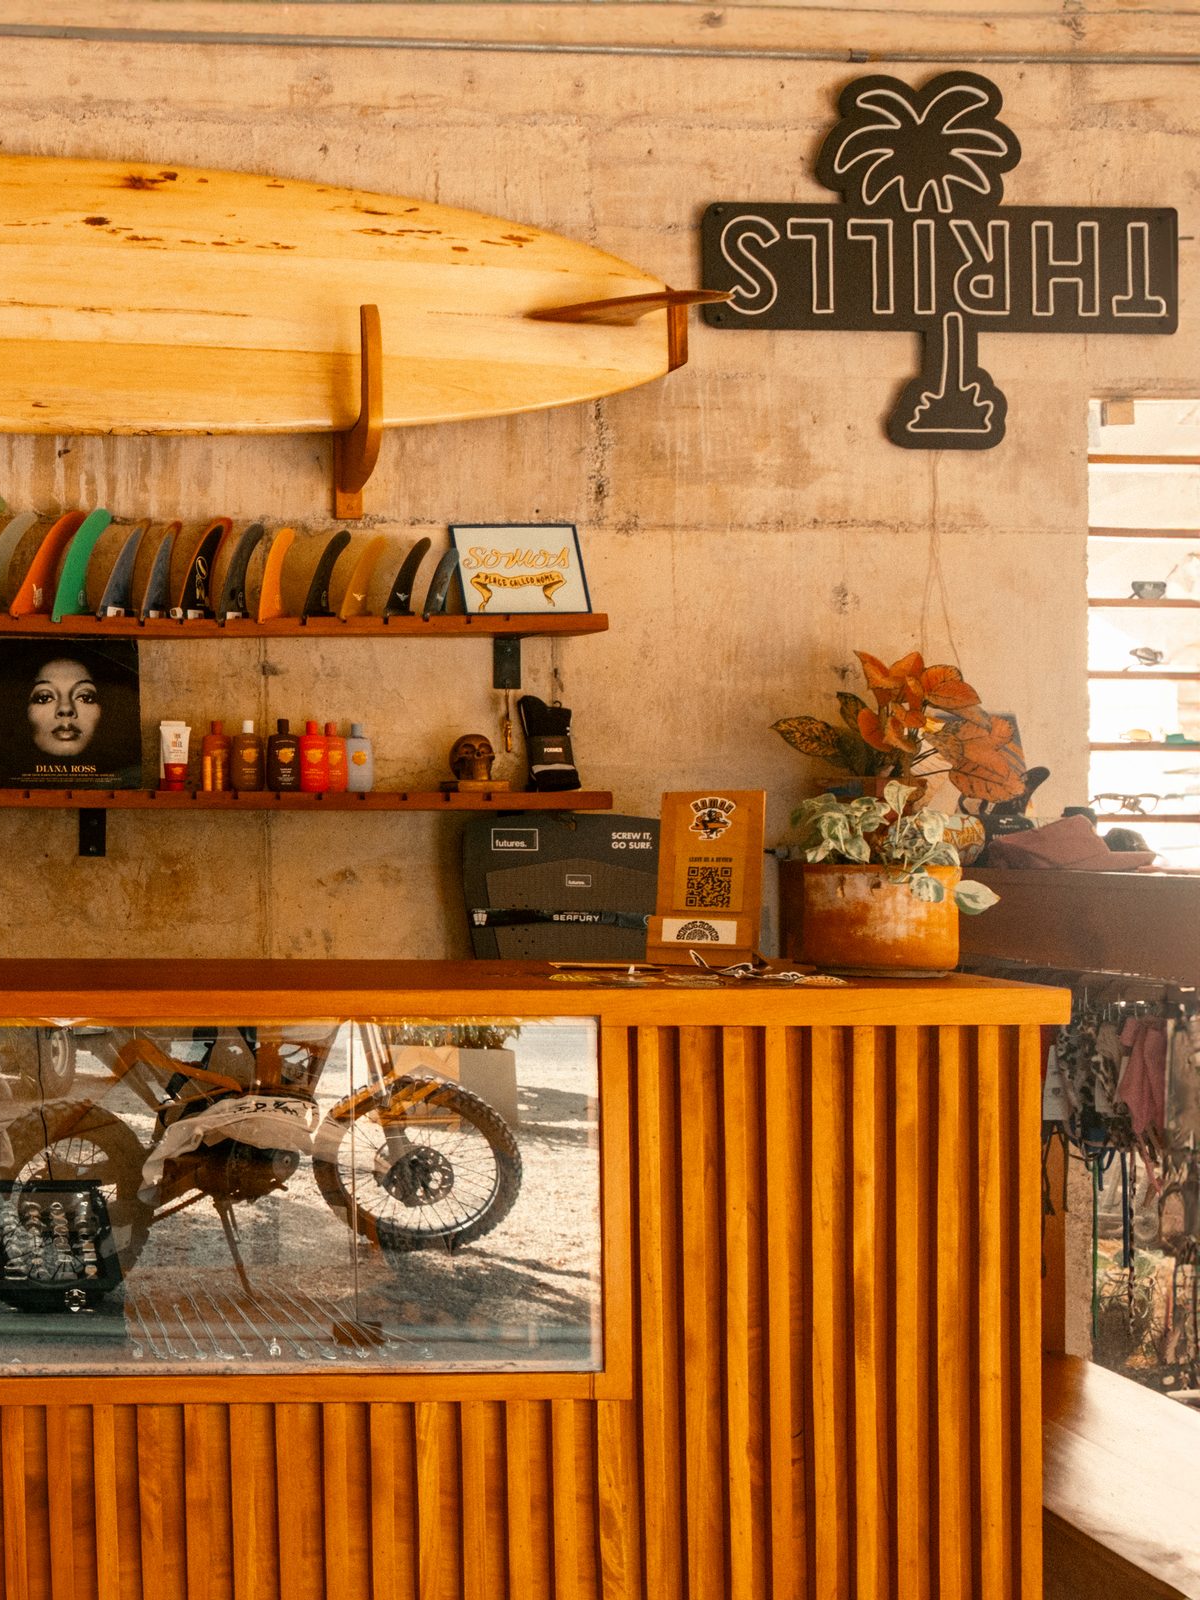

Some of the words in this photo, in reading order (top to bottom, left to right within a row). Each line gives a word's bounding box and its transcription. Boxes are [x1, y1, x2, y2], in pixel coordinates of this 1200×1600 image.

[720, 215, 1167, 318] THRILLS
[35, 765, 68, 773] DIANA
[71, 765, 97, 773] ROSS
[611, 832, 641, 840] SCREW
[495, 838, 527, 848] futures.
[611, 841, 626, 849] GO
[629, 841, 653, 849] SURF.
[553, 914, 600, 922] SEAFURY
